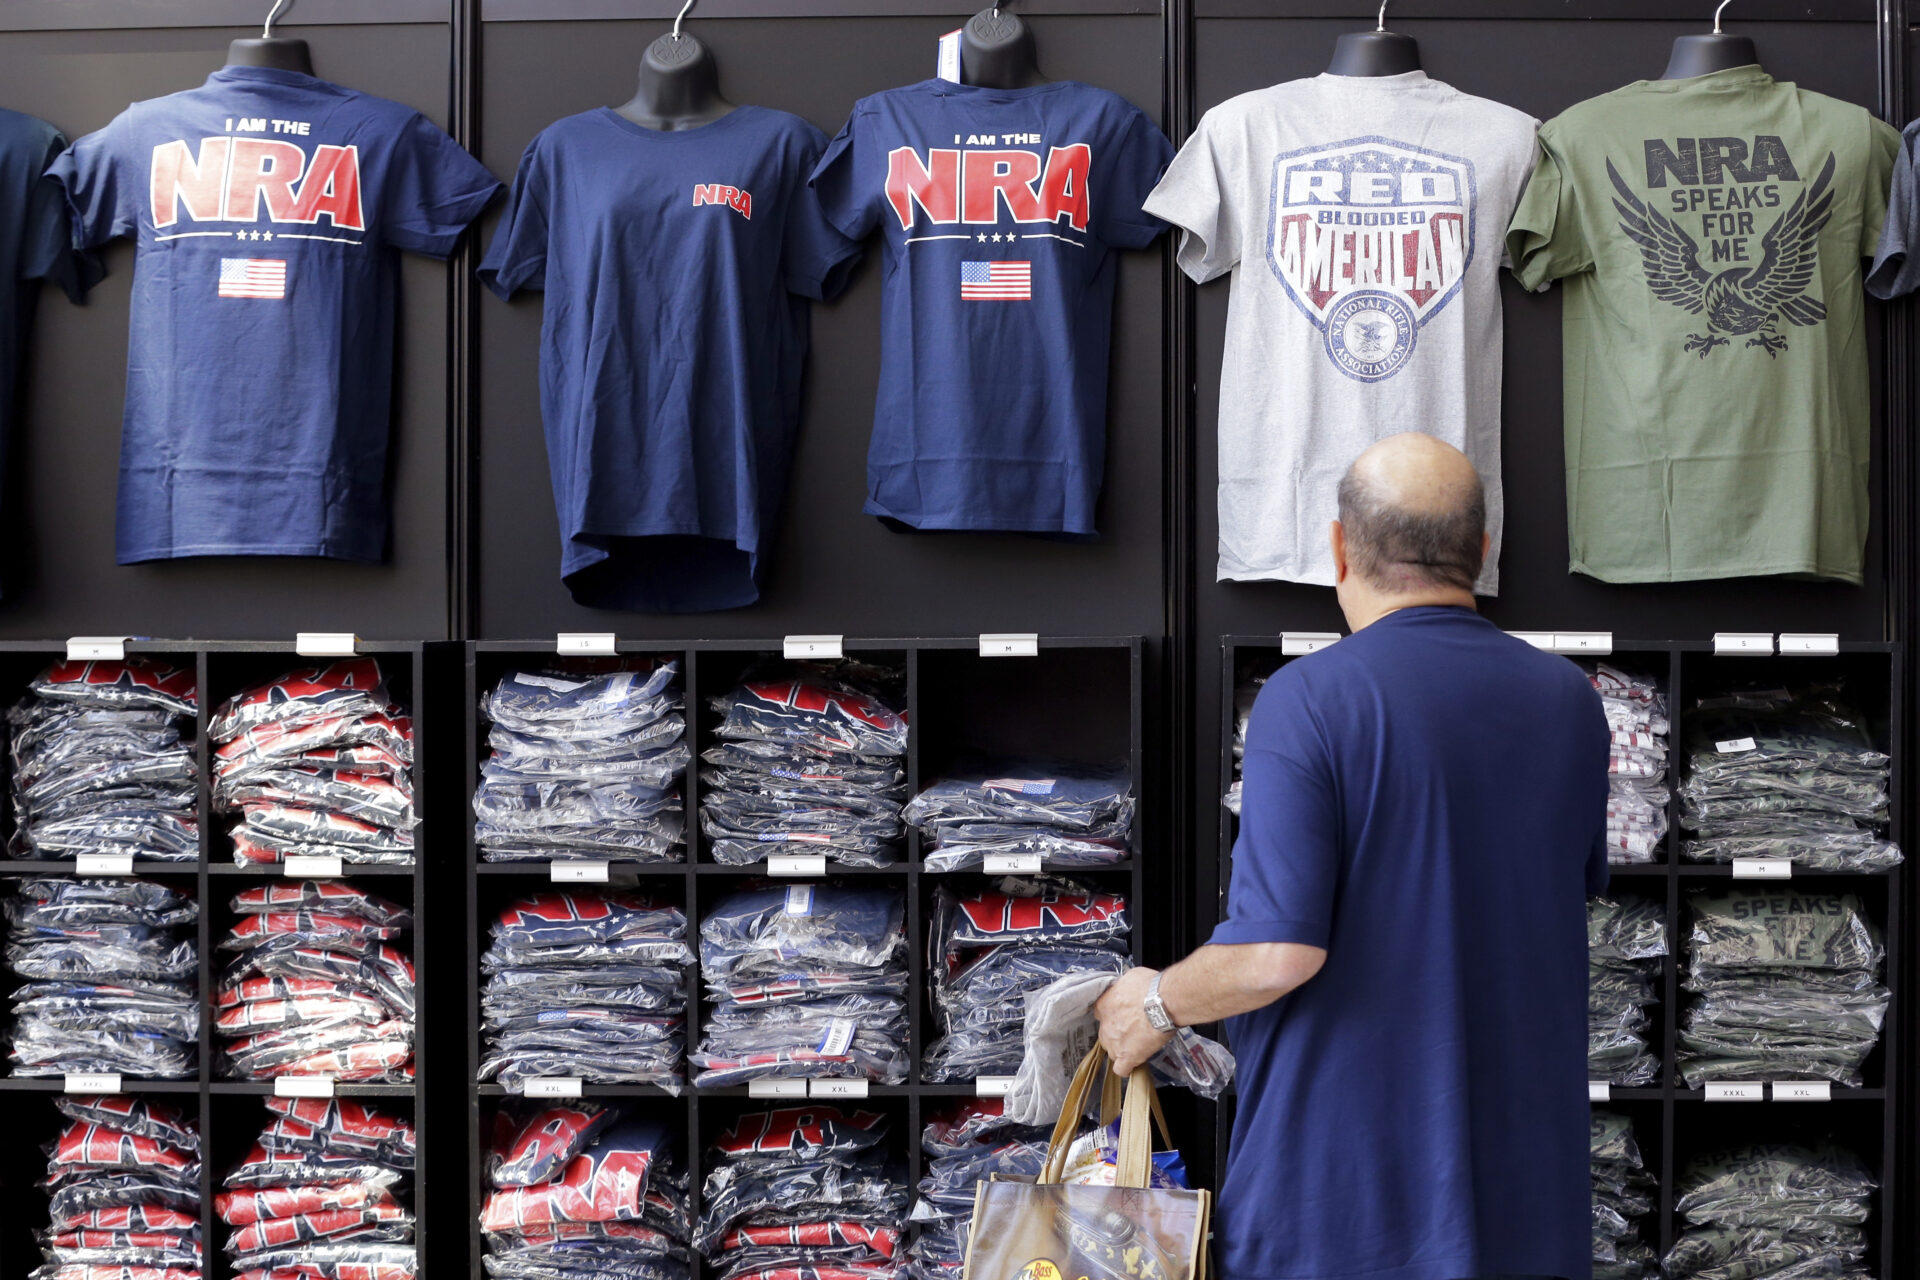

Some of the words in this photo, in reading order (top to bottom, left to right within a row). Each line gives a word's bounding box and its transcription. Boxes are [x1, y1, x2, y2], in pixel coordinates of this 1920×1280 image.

[226, 119, 232, 132] I
[236, 118, 267, 133] AM
[271, 120, 311, 136] THE
[954, 134, 961, 145] I
[965, 134, 996, 146] AM
[1001, 133, 1042, 145] THE
[1644, 135, 1800, 188] NRA
[150, 137, 366, 232] NRA
[885, 143, 1091, 232] NRA
[1288, 170, 1458, 204] RED
[1671, 184, 1781, 213] SPEAKS
[692, 183, 752, 220] NRA
[1317, 210, 1426, 226] BLOODED
[1702, 211, 1755, 237] FOR
[1280, 217, 1465, 292] AMERICAN
[1711, 238, 1750, 263] ME
[1333, 299, 1382, 337] NATIONAL
[1385, 304, 1409, 335] RIFLE
[1335, 343, 1405, 375] ASSOCIATION
[1732, 898, 1843, 920] SPEAKS
[1033, 1262, 1052, 1277] Bass
